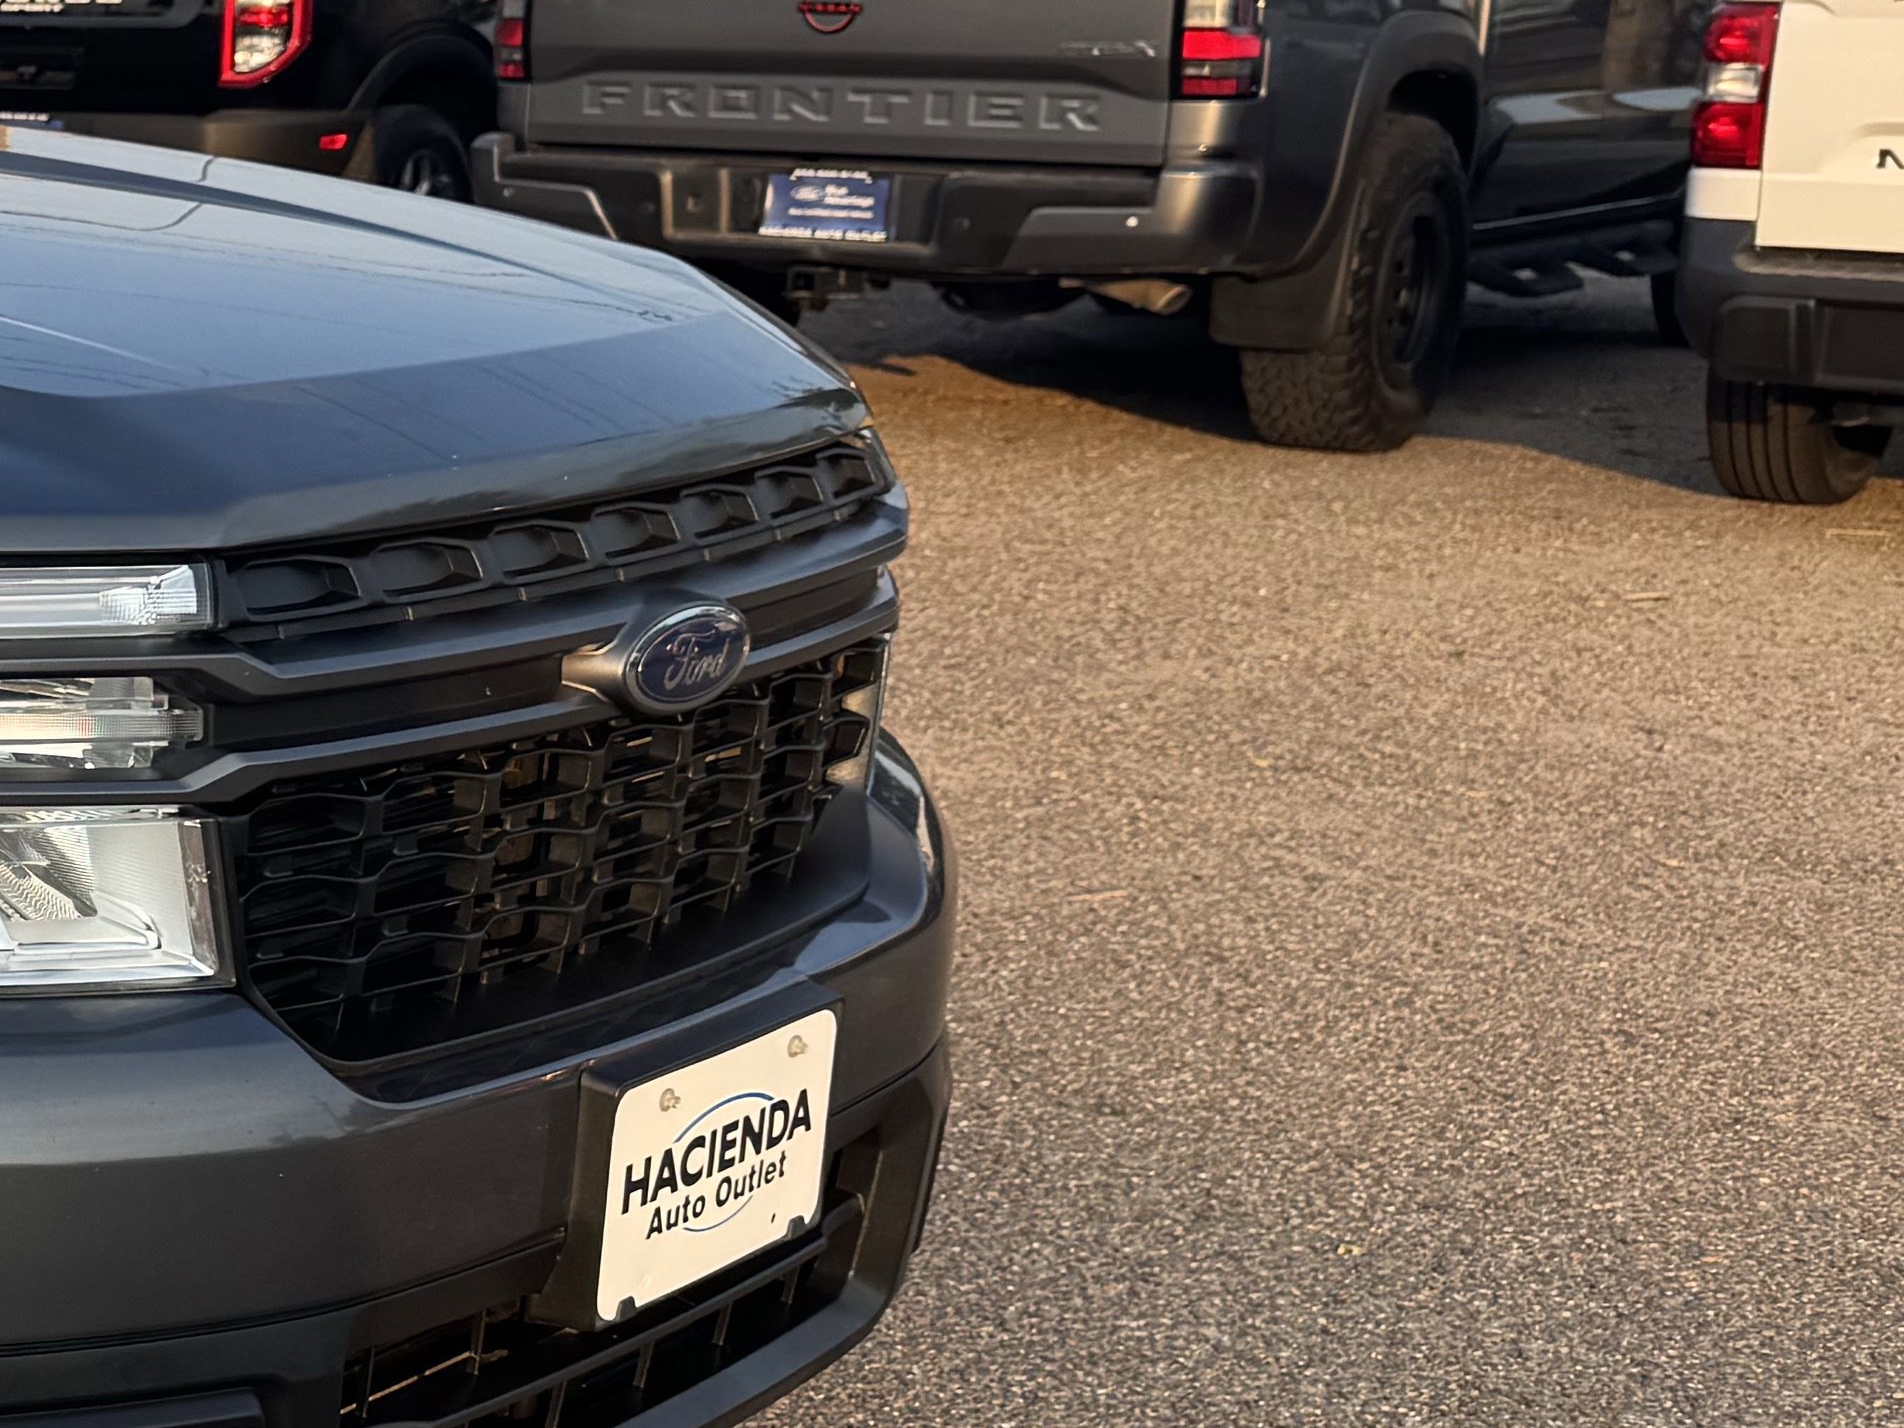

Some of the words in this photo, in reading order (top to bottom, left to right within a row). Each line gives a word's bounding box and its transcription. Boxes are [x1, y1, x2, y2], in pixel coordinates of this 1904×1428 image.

[582, 80, 1100, 132] FRONTIER
[621, 1088, 812, 1216] HACIENDA
[645, 1194, 707, 1240] Auto
[715, 1149, 787, 1207] Outlet
